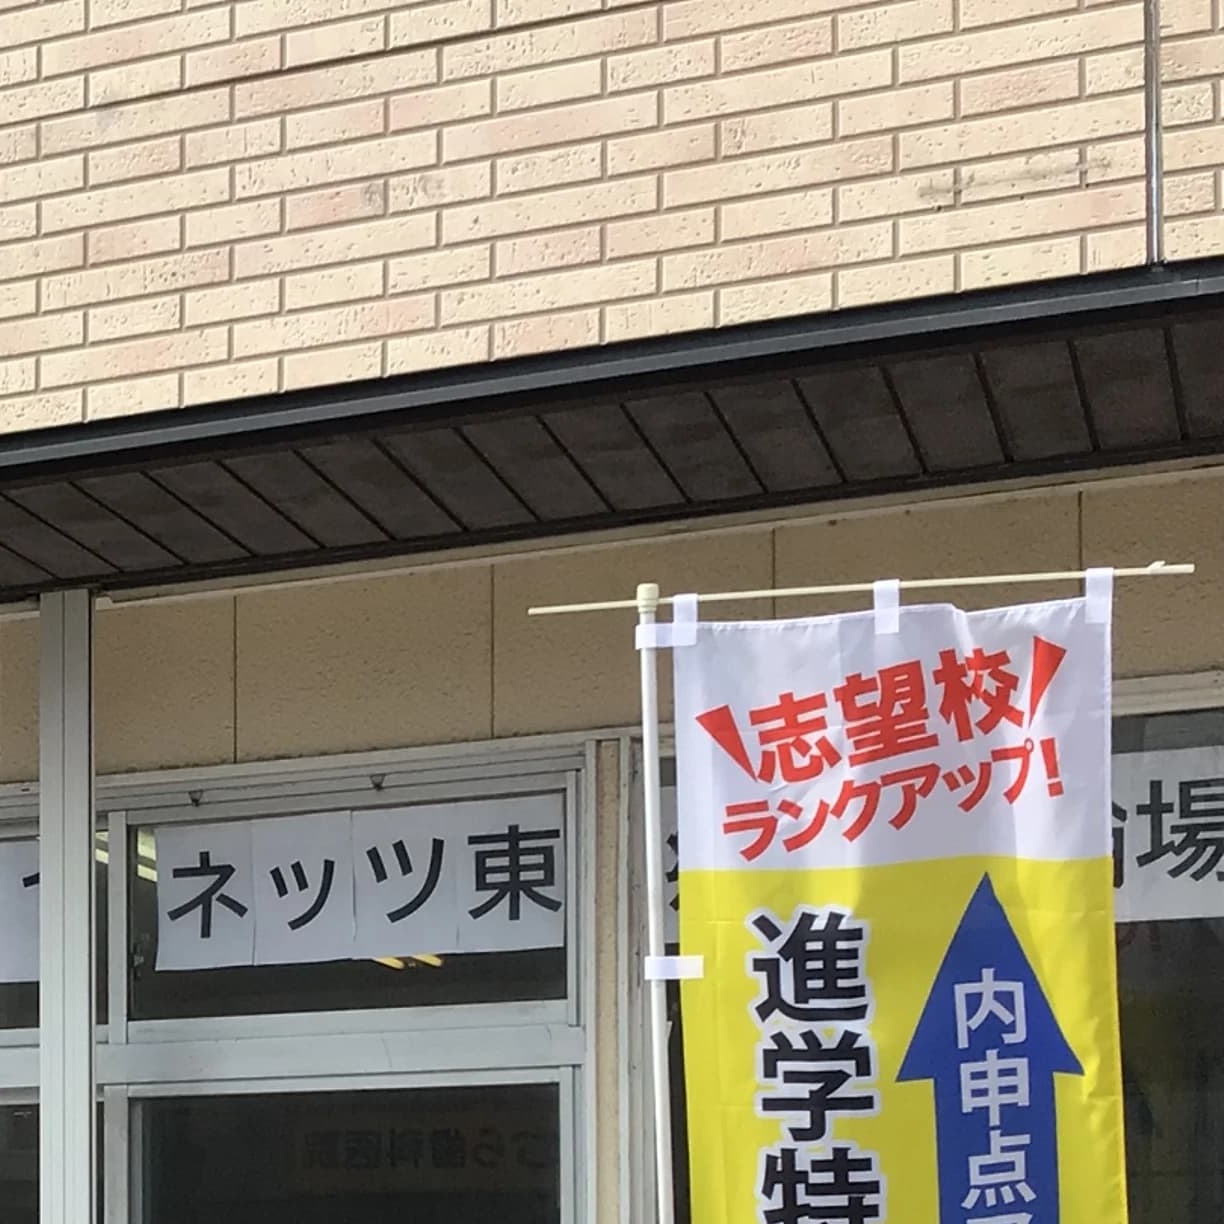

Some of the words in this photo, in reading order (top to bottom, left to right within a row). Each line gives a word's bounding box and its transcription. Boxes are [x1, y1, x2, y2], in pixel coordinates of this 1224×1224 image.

[749, 648, 1025, 784] 志望校
[723, 738, 1064, 862] ランクアップ!
[167, 825, 562, 939] ネッツ東
